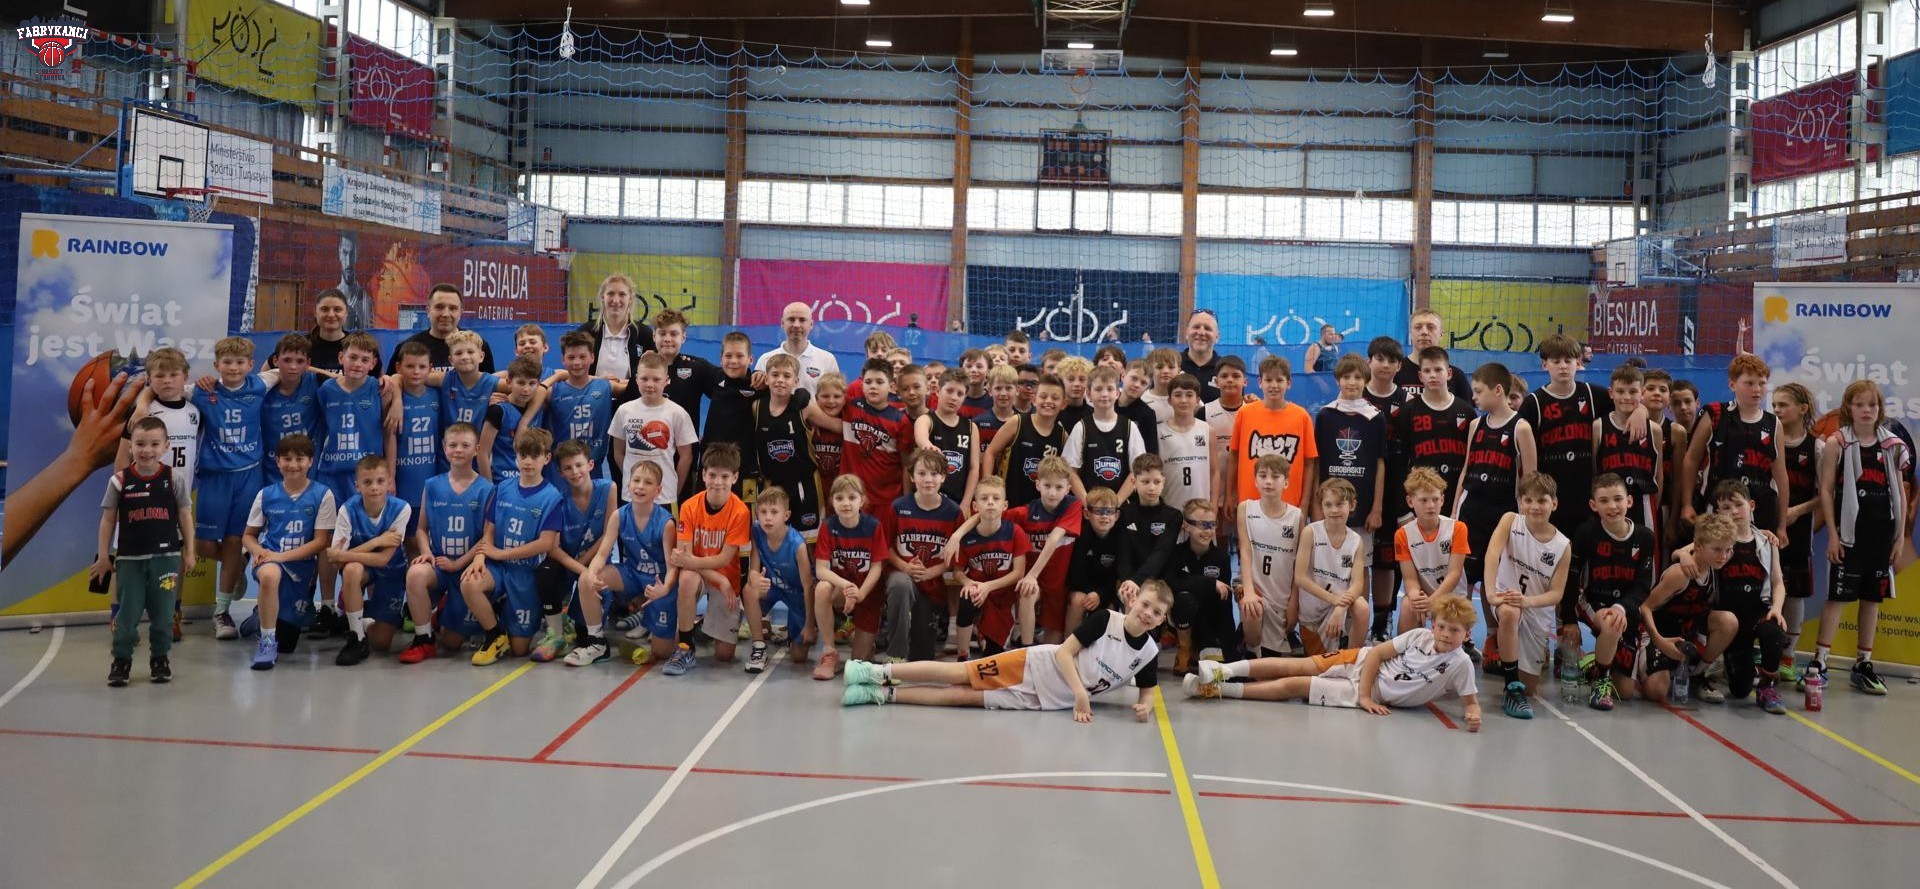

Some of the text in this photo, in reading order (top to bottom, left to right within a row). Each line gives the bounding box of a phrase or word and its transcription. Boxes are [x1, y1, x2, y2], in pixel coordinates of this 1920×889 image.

[210, 142, 255, 164] Ministerstwo
[67, 238, 168, 257] RAINBOW
[463, 259, 528, 300] BIESIADA
[70, 286, 181, 327] Świat
[478, 305, 514, 320] CATERING
[1796, 303, 1892, 318] RAINBOW
[1593, 300, 1659, 337] BIESIADA
[26, 326, 103, 366] jest
[1801, 347, 1909, 385] Świat
[224, 408, 242, 424] 15
[457, 408, 474, 423] 18
[573, 404, 591, 419] 35
[1544, 402, 1563, 420] 45
[281, 412, 302, 428] 33
[341, 413, 356, 428] 13
[411, 417, 431, 433] 27
[787, 421, 795, 434] 1
[1412, 415, 1433, 432] 28
[956, 434, 970, 448] 12
[1115, 438, 1124, 453] 2
[171, 446, 186, 468] 15
[1095, 460, 1121, 469] JUNAK
[1182, 467, 1192, 486] 8
[1328, 465, 1366, 474] EUROBASKET
[128, 506, 170, 524] POLONIA
[285, 519, 304, 533] 40
[447, 515, 465, 532] 10
[508, 517, 524, 535] 31
[900, 533, 949, 547] FABRYKANCI
[1262, 555, 1273, 576] 6
[1518, 574, 1529, 595] 5
[516, 609, 531, 624] 31
